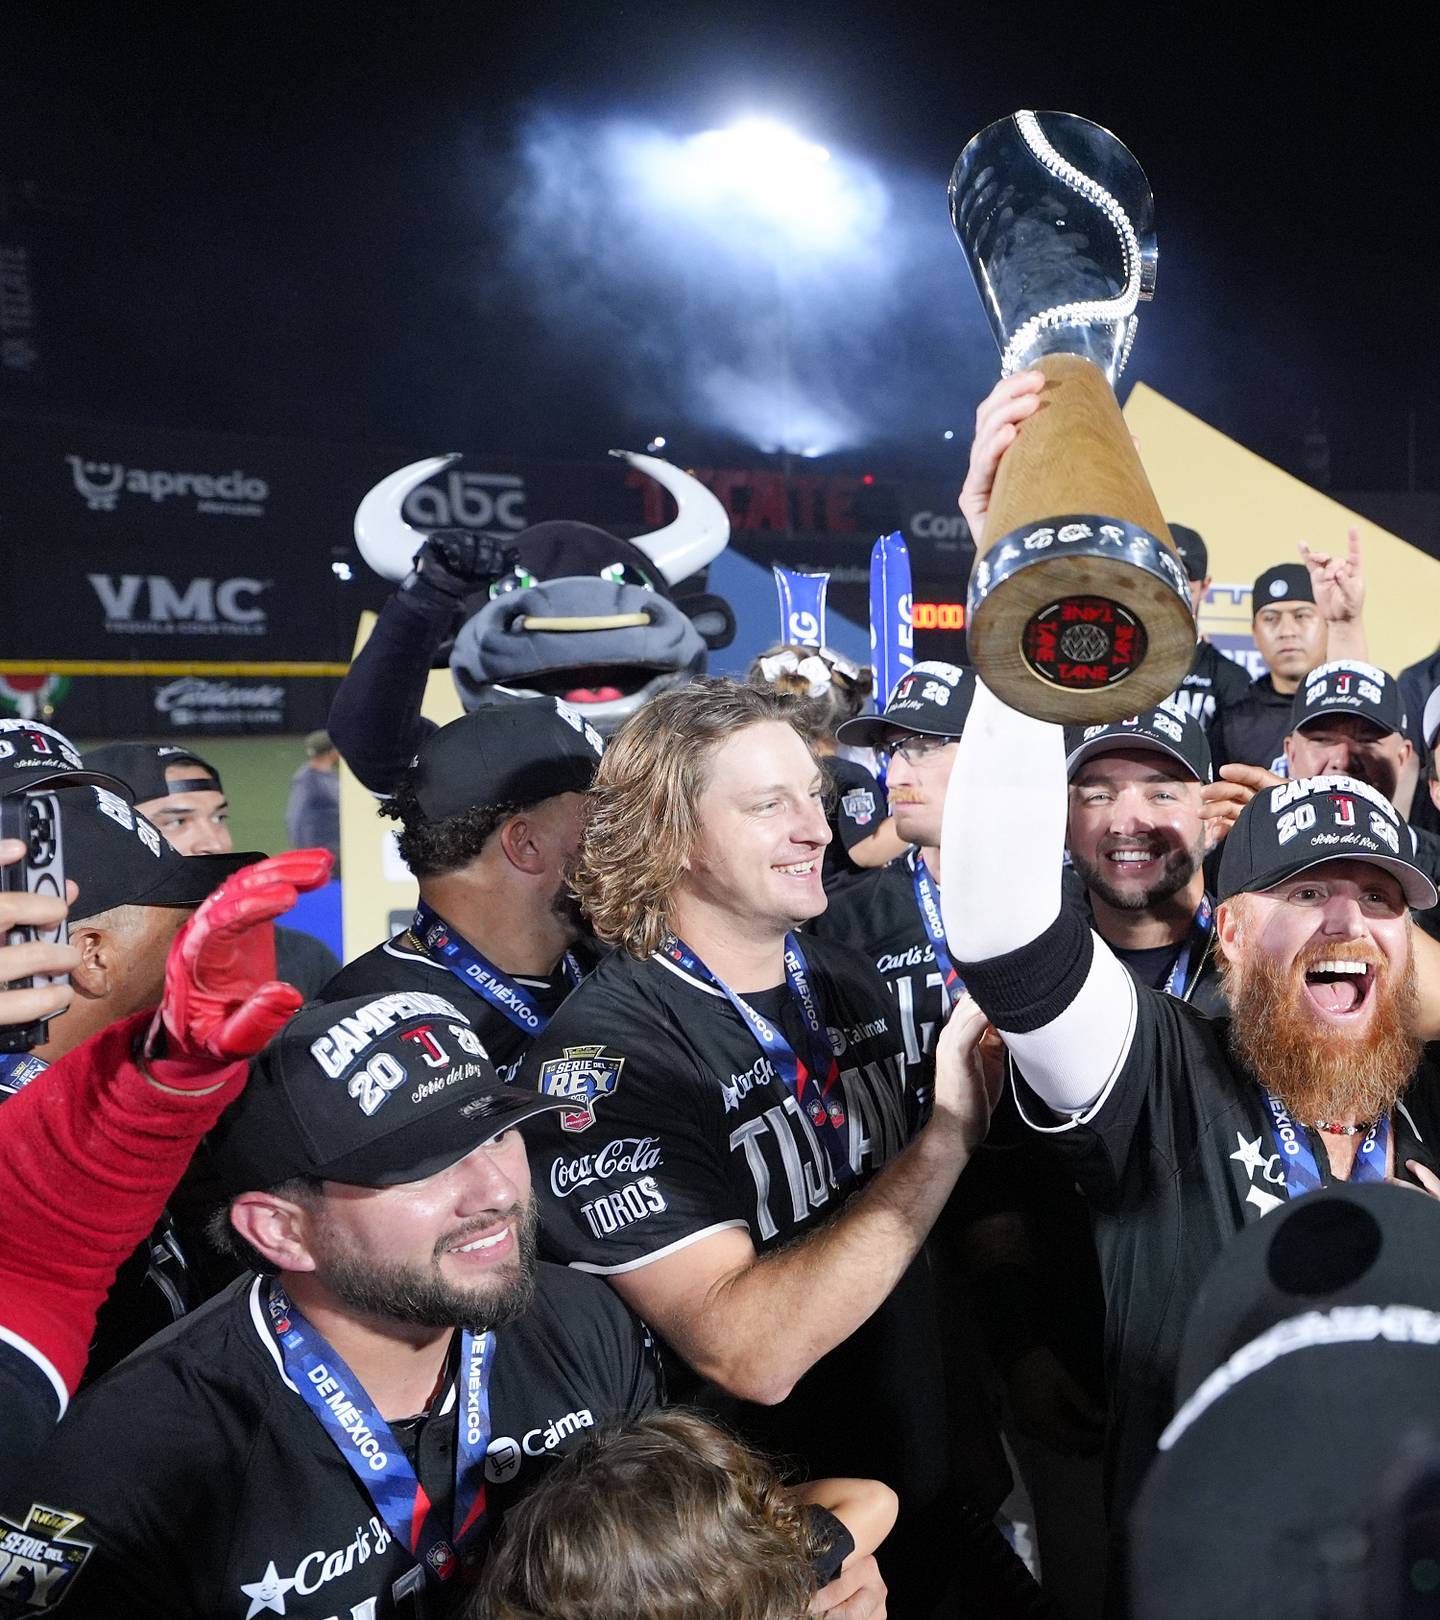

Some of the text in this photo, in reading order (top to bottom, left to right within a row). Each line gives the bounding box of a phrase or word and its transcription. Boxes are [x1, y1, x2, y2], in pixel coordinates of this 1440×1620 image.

[407, 471, 527, 530] abc
[624, 468, 859, 532] TCATE
[87, 573, 269, 624] VMC
[1058, 663, 1110, 682] TANE
[1270, 775, 1401, 827] CAMPEONES
[1276, 802, 1317, 846] 20
[1340, 831, 1359, 845] del
[877, 945, 922, 973] Carl's
[466, 963, 540, 1028] DE MÉXICO
[309, 991, 471, 1080] CAMPEONES
[347, 1052, 407, 1117] 20
[447, 1067, 464, 1086] del
[546, 1070, 613, 1097] REY
[557, 1060, 593, 1074] SERIE
[550, 1136, 663, 1198] Coca-Cola
[580, 1175, 669, 1240] TOROS
[307, 1363, 388, 1472] DE MÉXICO
[467, 1356, 483, 1445] MÉXICO
[1, 1531, 50, 1561] SERIE
[294, 1525, 372, 1595] Carl's
